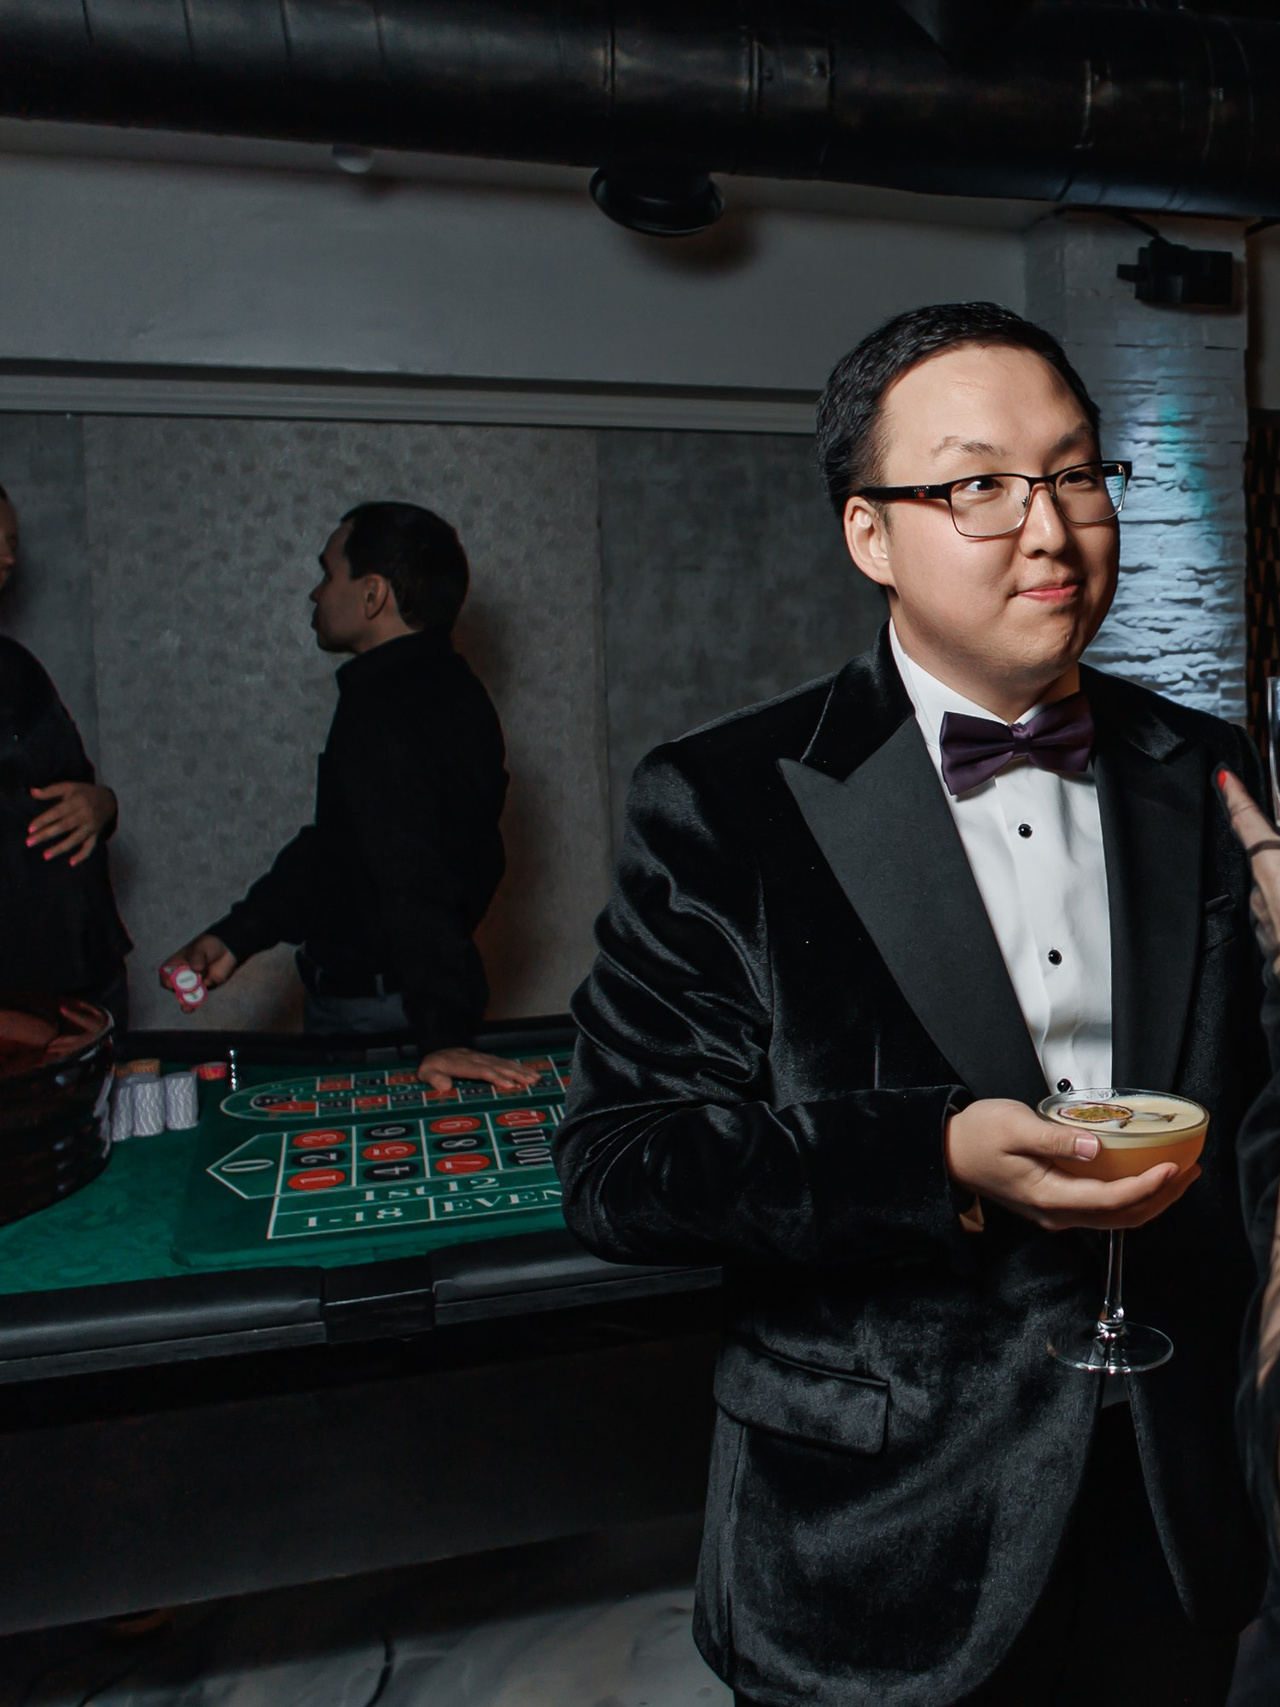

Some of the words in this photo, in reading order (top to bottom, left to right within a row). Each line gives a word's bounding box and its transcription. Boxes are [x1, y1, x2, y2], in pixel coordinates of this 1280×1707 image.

[504, 1110, 540, 1126] 12
[439, 1120, 473, 1131] 9
[371, 1126, 406, 1137] 6
[510, 1128, 546, 1144] 11
[302, 1133, 337, 1144] 3
[442, 1138, 477, 1149] 8
[373, 1145, 409, 1155] 5
[515, 1147, 553, 1164] 10
[301, 1153, 337, 1164] 2
[221, 1159, 274, 1172] 0
[373, 1165, 410, 1176] 4
[445, 1160, 482, 1170] 7
[300, 1174, 336, 1184] 1
[447, 1177, 500, 1193] 12
[304, 1207, 403, 1228] 1-18
